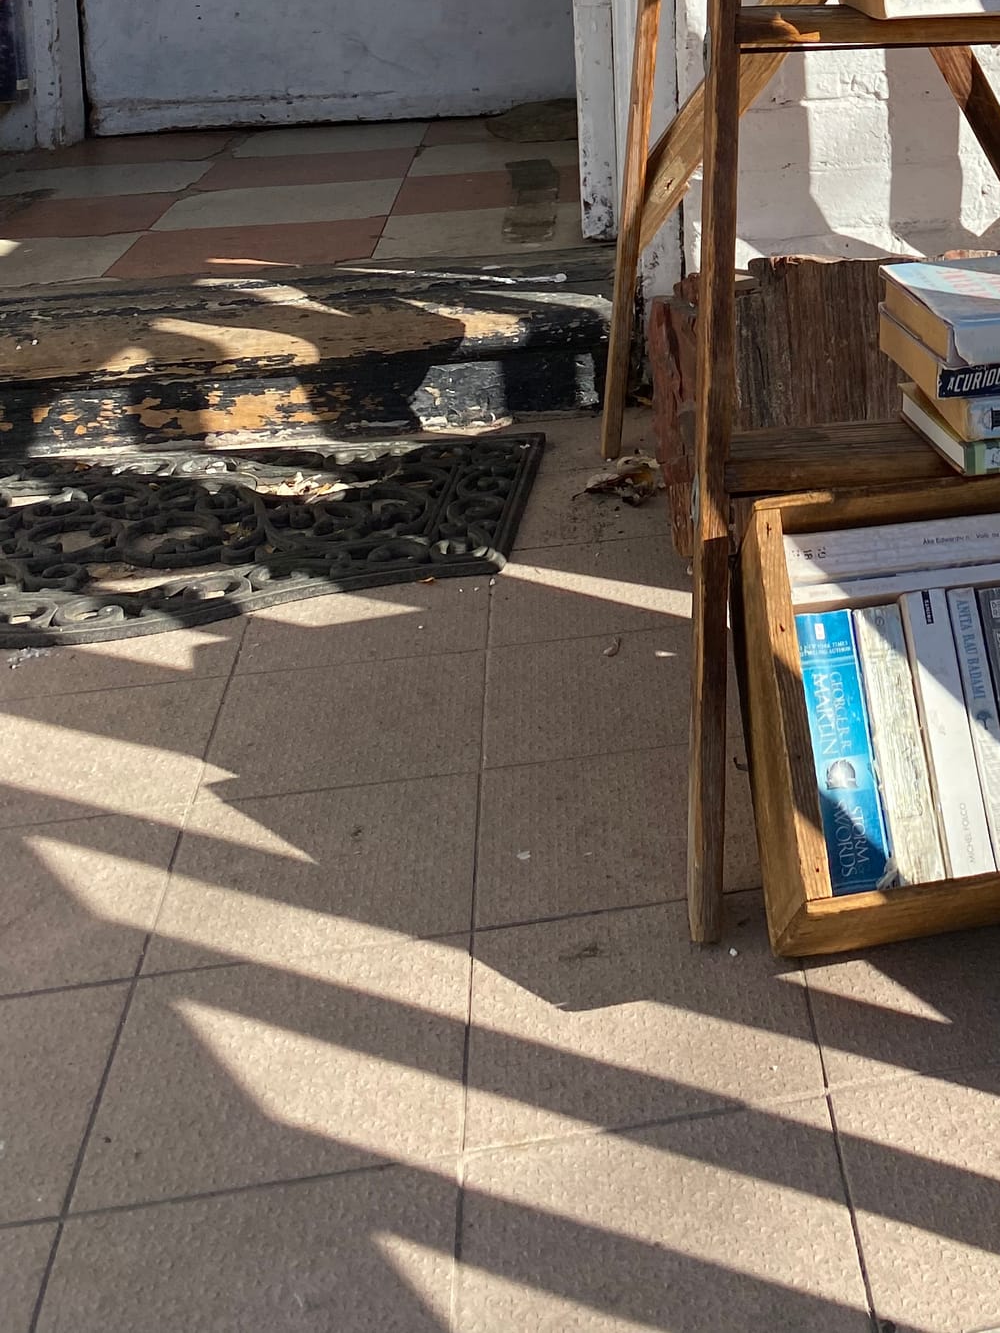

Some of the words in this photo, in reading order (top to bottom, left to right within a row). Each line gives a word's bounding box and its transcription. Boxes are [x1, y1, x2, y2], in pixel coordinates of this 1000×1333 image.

[948, 377, 955, 391] A
[956, 599, 970, 631] ANITA
[963, 632, 977, 655] RAU
[829, 671, 848, 722] GEORGE
[968, 657, 986, 699] BADAMI
[812, 673, 838, 755] MARTIN
[834, 799, 858, 878] SWORDS
[854, 806, 870, 864] STORM
